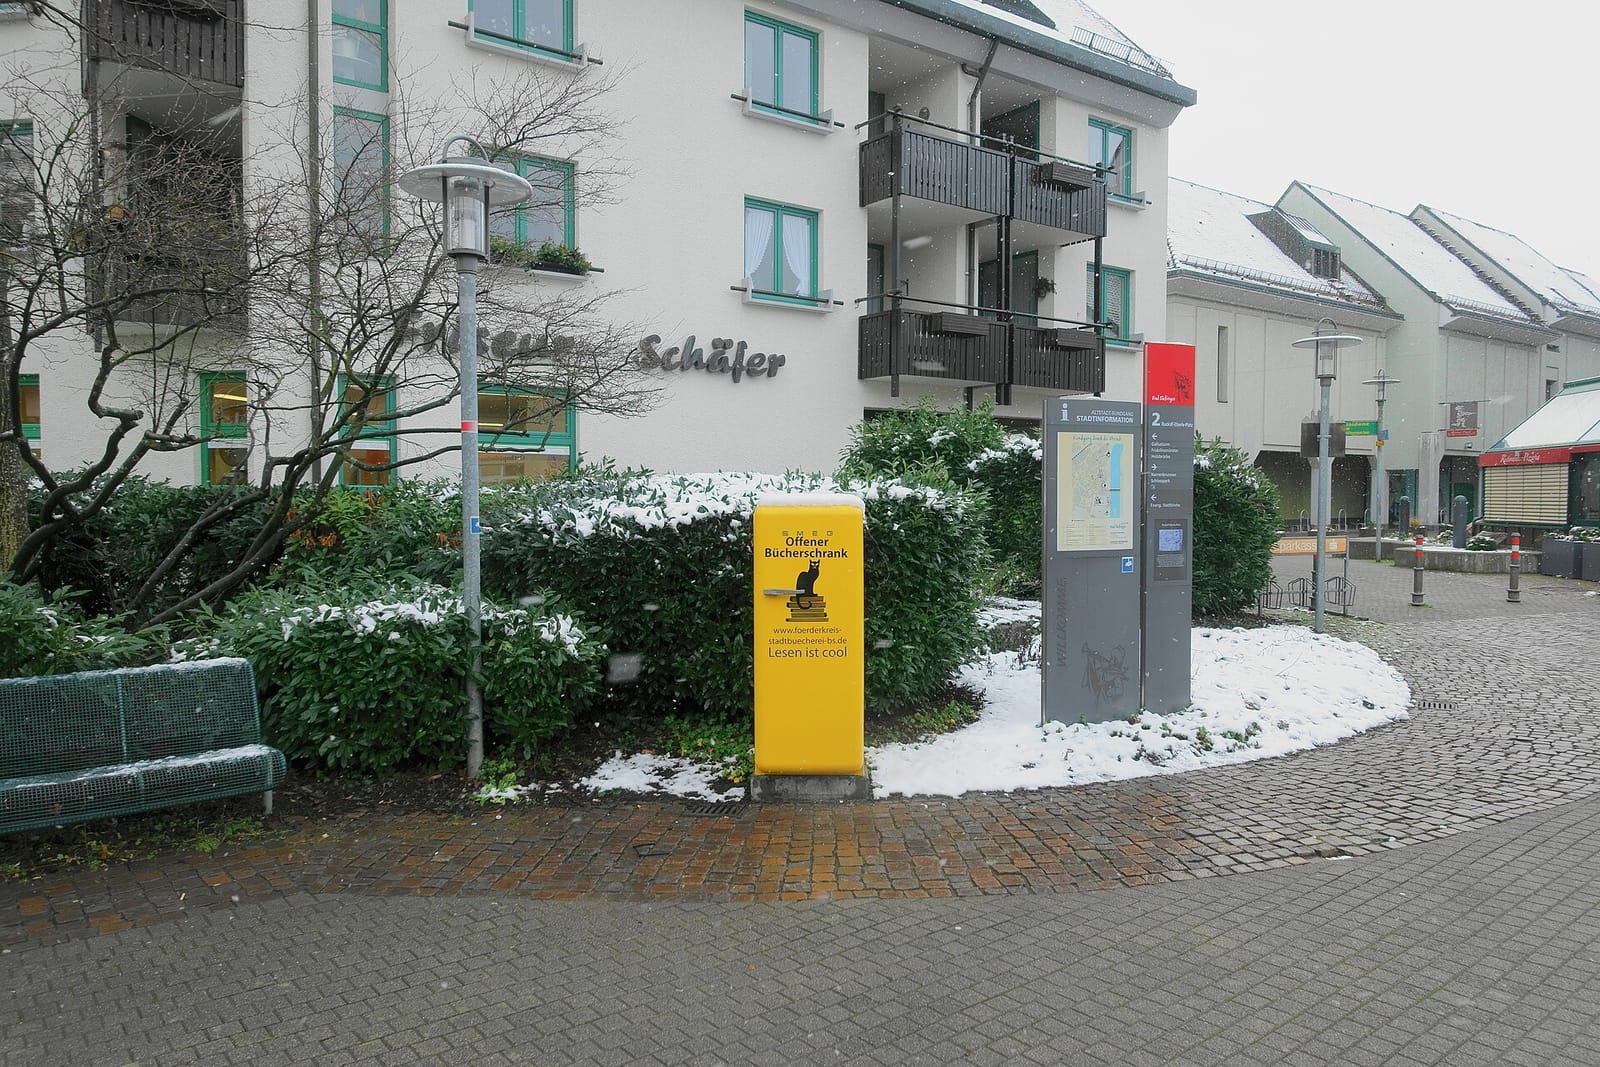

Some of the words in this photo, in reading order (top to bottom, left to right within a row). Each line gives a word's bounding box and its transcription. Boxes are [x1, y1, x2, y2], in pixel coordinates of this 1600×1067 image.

[639, 334, 786, 383] Schäfer
[1076, 415, 1134, 424] STADTINFORMATION
[1151, 412, 1161, 426] 2
[785, 536, 830, 547] Offener
[764, 547, 848, 558] Bücherschrank
[773, 626, 842, 634] www.foerderkreis-
[768, 637, 848, 645] stadtbuecherei-bs.de
[768, 647, 802, 658] Lesen
[805, 647, 820, 658] ist
[822, 647, 847, 658] cool
